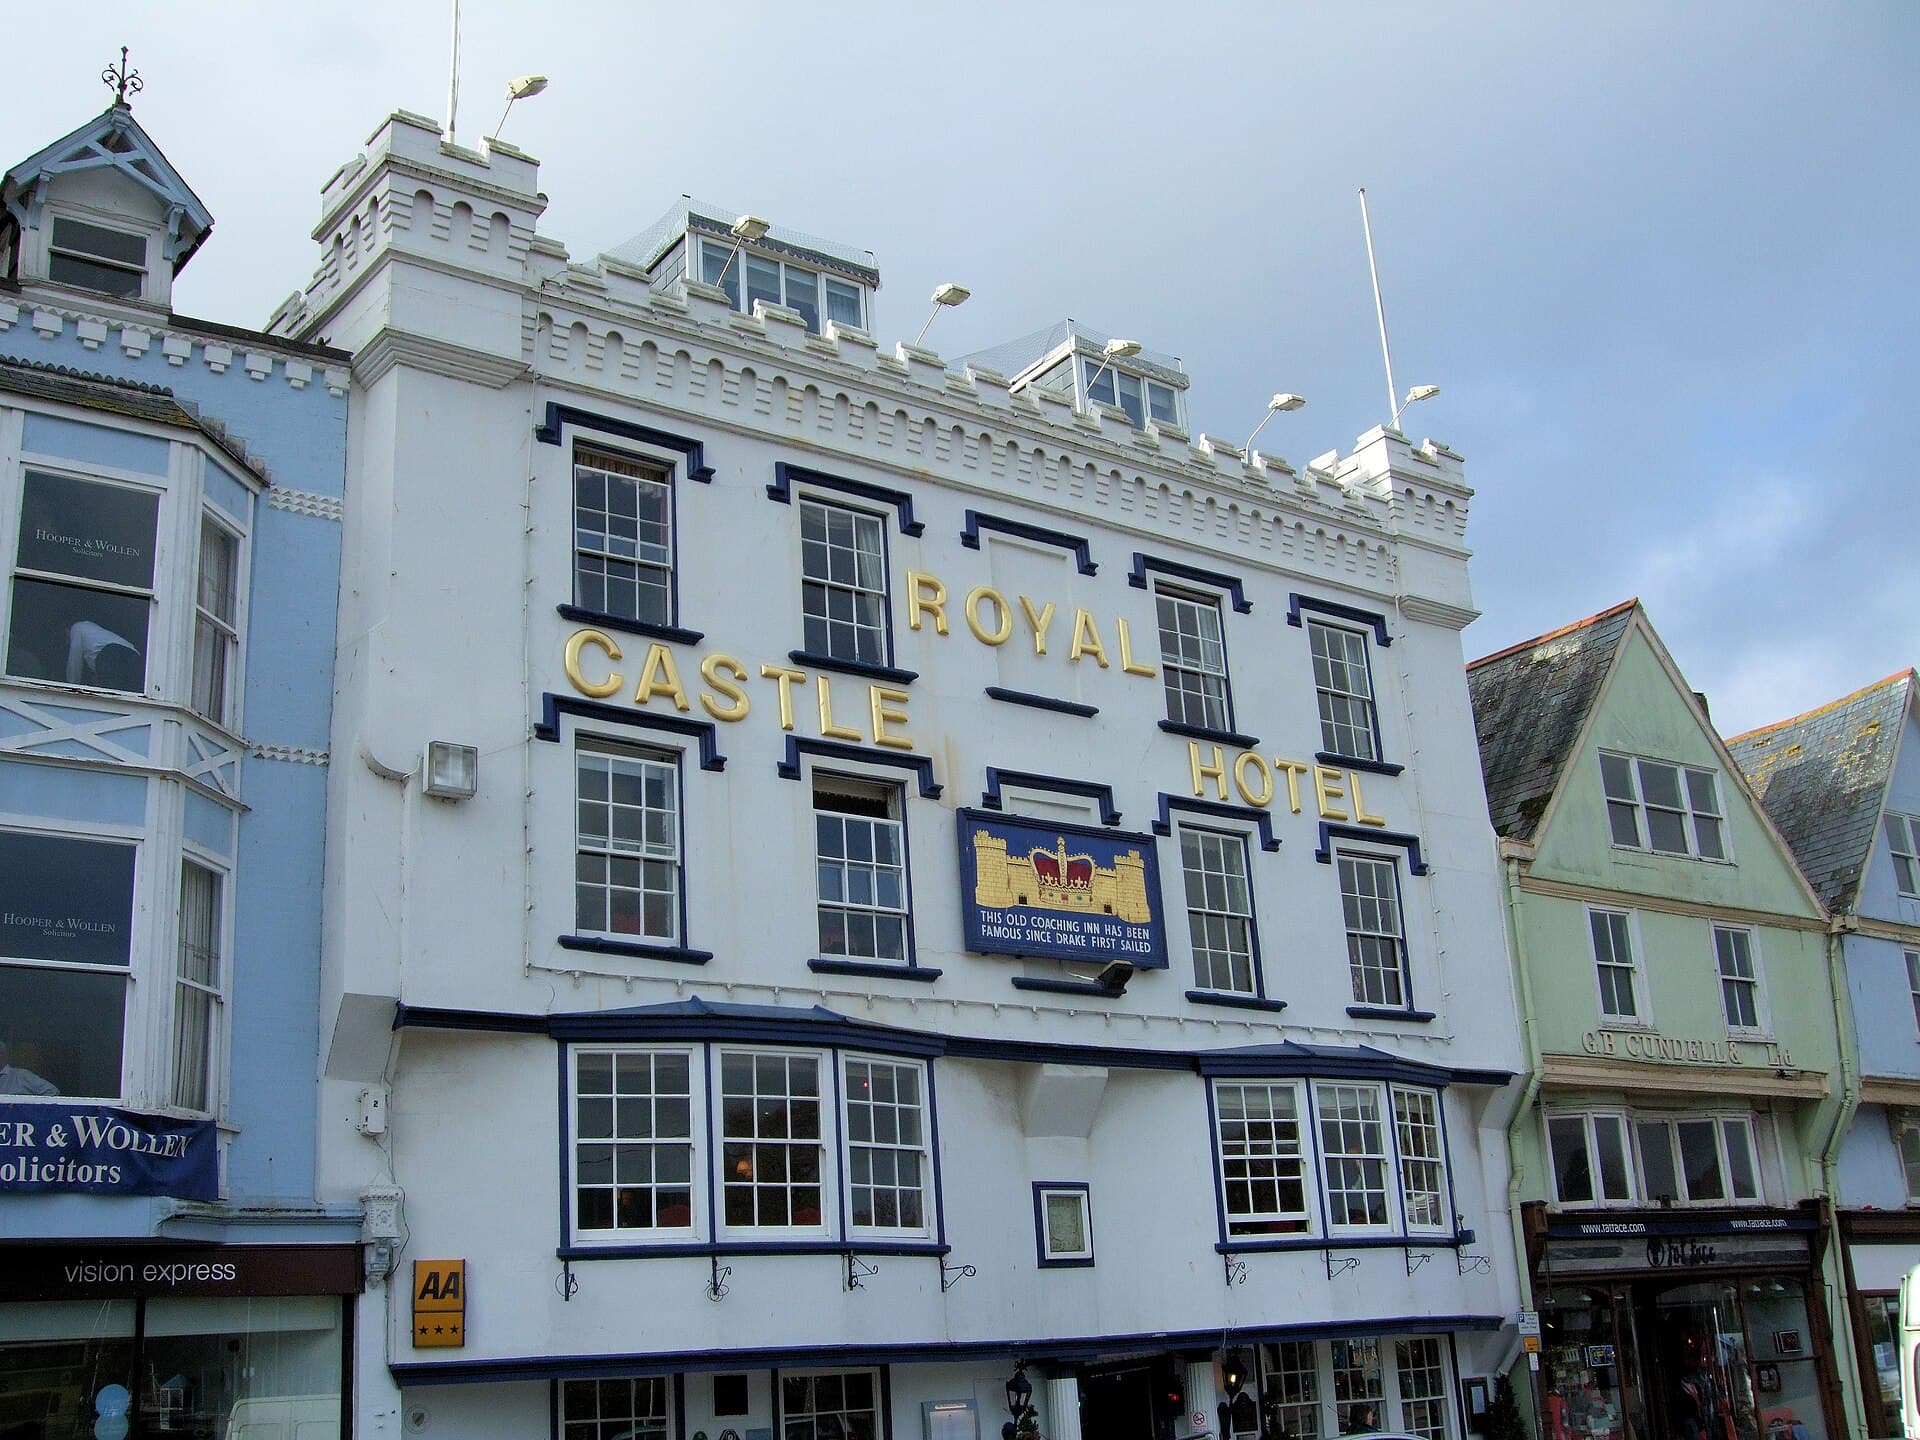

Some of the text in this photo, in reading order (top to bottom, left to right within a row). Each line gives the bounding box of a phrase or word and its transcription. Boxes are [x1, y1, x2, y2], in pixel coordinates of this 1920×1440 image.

[84, 540, 93, 548] &
[907, 570, 1157, 678] ROYAL
[564, 628, 914, 750] CASTLE
[1187, 740, 1386, 827] HOTEL
[55, 920, 64, 928] &
[980, 910, 1150, 940] THIS OLD COACHING INN HAS BEEN
[981, 924, 1151, 953] FAMOUS SINCE DRAKE FIRST SAILED
[1625, 1034, 1727, 1064] CUNDELL
[1728, 1041, 1743, 1064] &
[45, 1123, 68, 1147] &
[65, 1260, 236, 1286] vision express
[418, 1271, 460, 1300] AA
